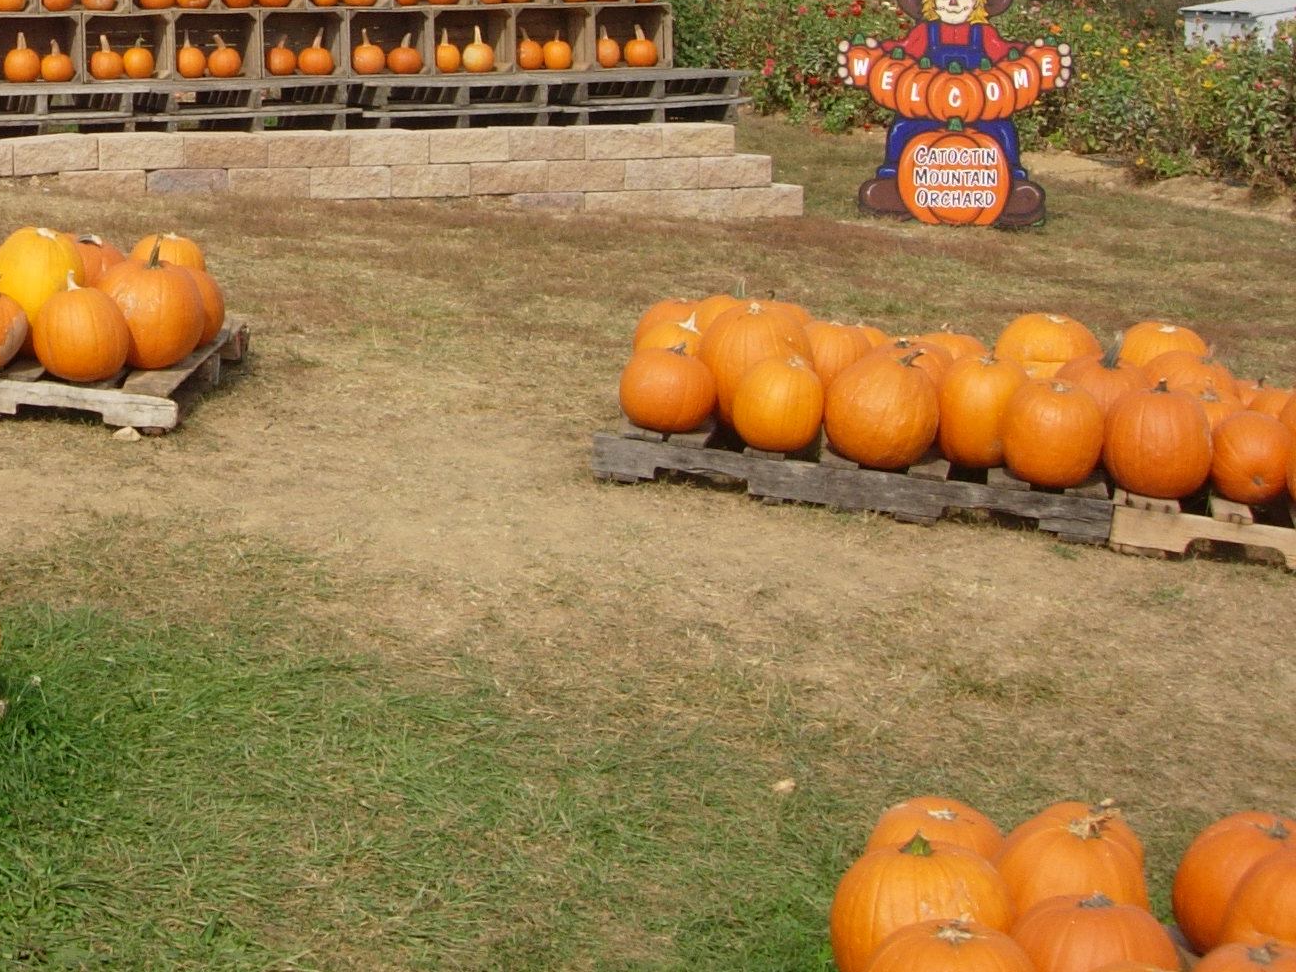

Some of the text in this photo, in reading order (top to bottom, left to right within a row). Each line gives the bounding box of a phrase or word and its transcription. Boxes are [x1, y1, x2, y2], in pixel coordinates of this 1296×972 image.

[853, 57, 1052, 108] WELCOME
[915, 146, 996, 164] CATOCTIN
[915, 168, 996, 185] MOUNTAIN
[916, 189, 994, 206] ORCHARD
